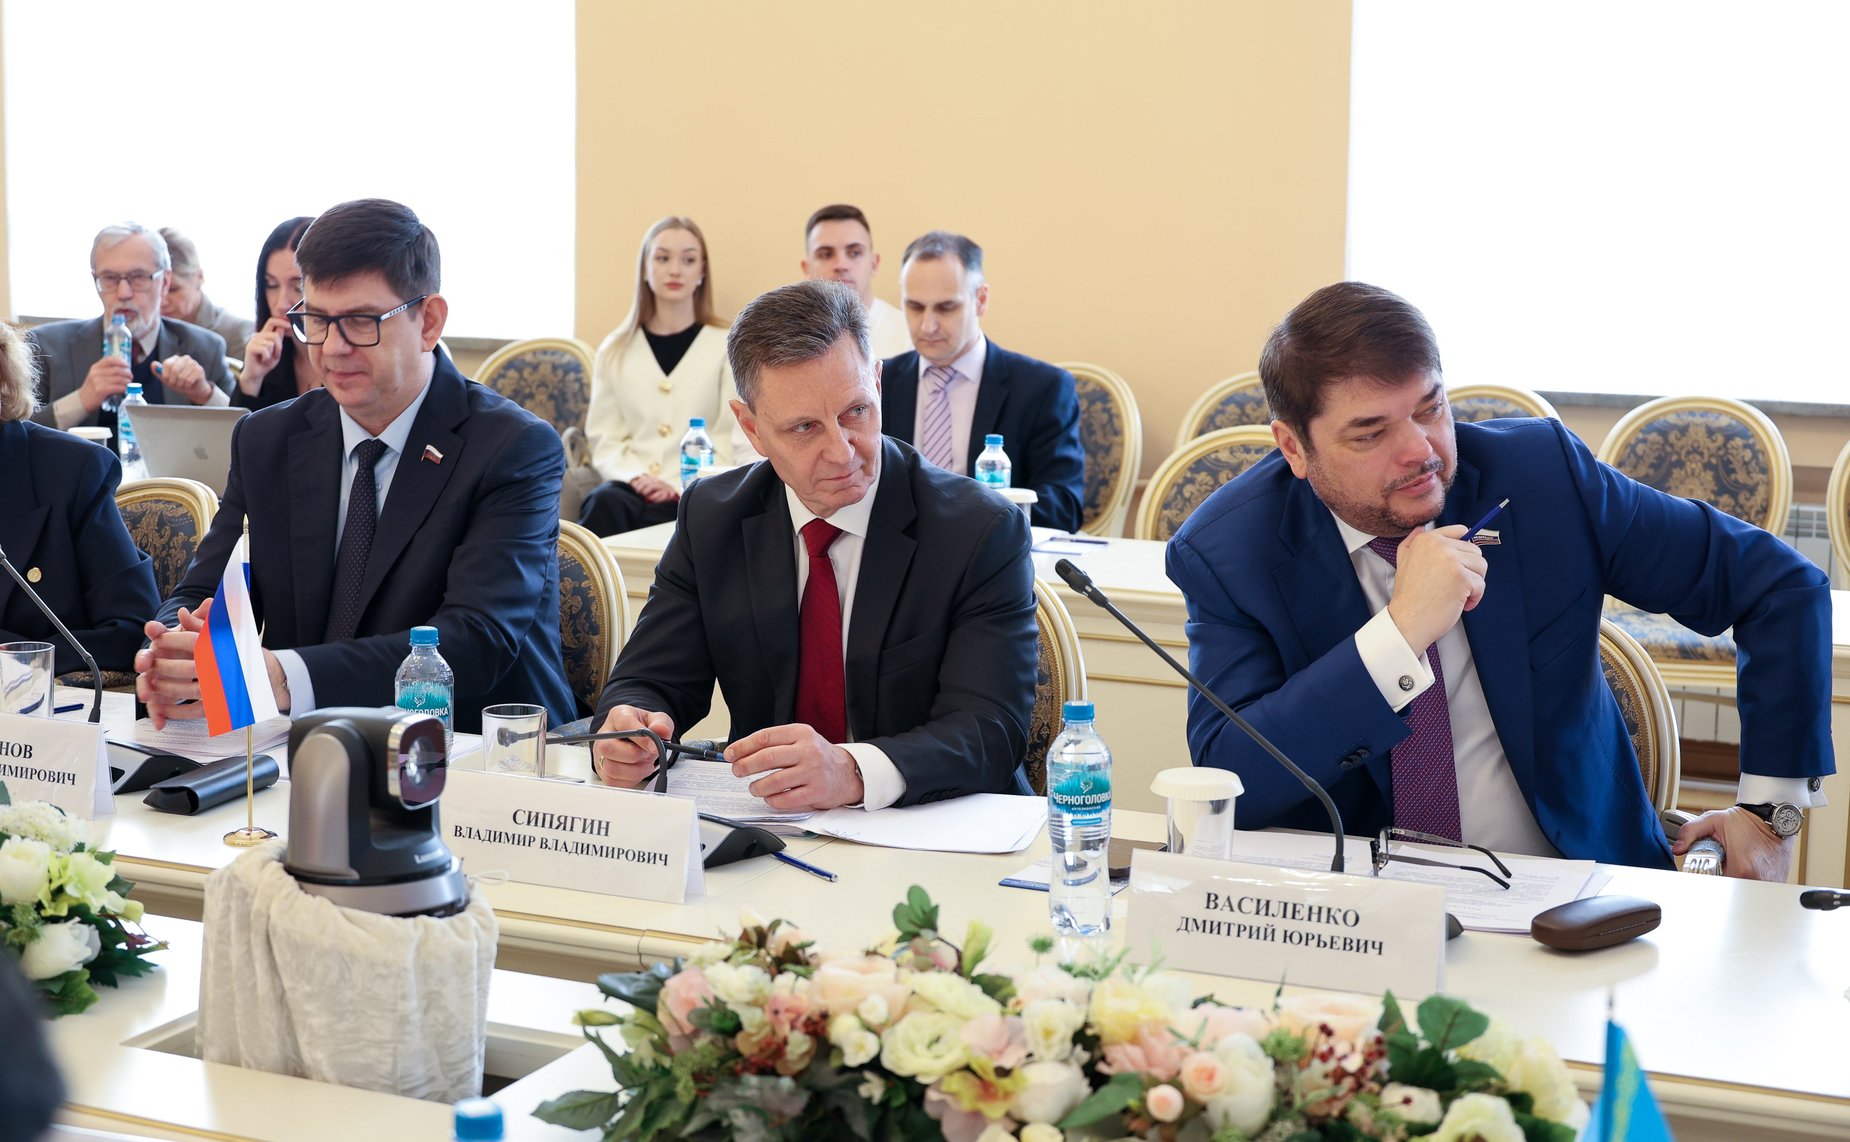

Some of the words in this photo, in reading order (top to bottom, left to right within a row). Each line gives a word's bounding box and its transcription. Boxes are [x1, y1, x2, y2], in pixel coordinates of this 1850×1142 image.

[0, 740, 33, 759] НОВ
[0, 763, 76, 786] ИМИРОВИЧ
[512, 808, 611, 837] СИПЯГИН
[453, 825, 536, 849] ВЛАДИМИР
[539, 837, 669, 867] ВЛАДИМИРОВИЧ
[1204, 891, 1360, 928] ВАСИЛЕНКО
[1176, 916, 1277, 943] ДМИТРИЙ
[1282, 929, 1384, 956] ЮРЬЕВИЧ
